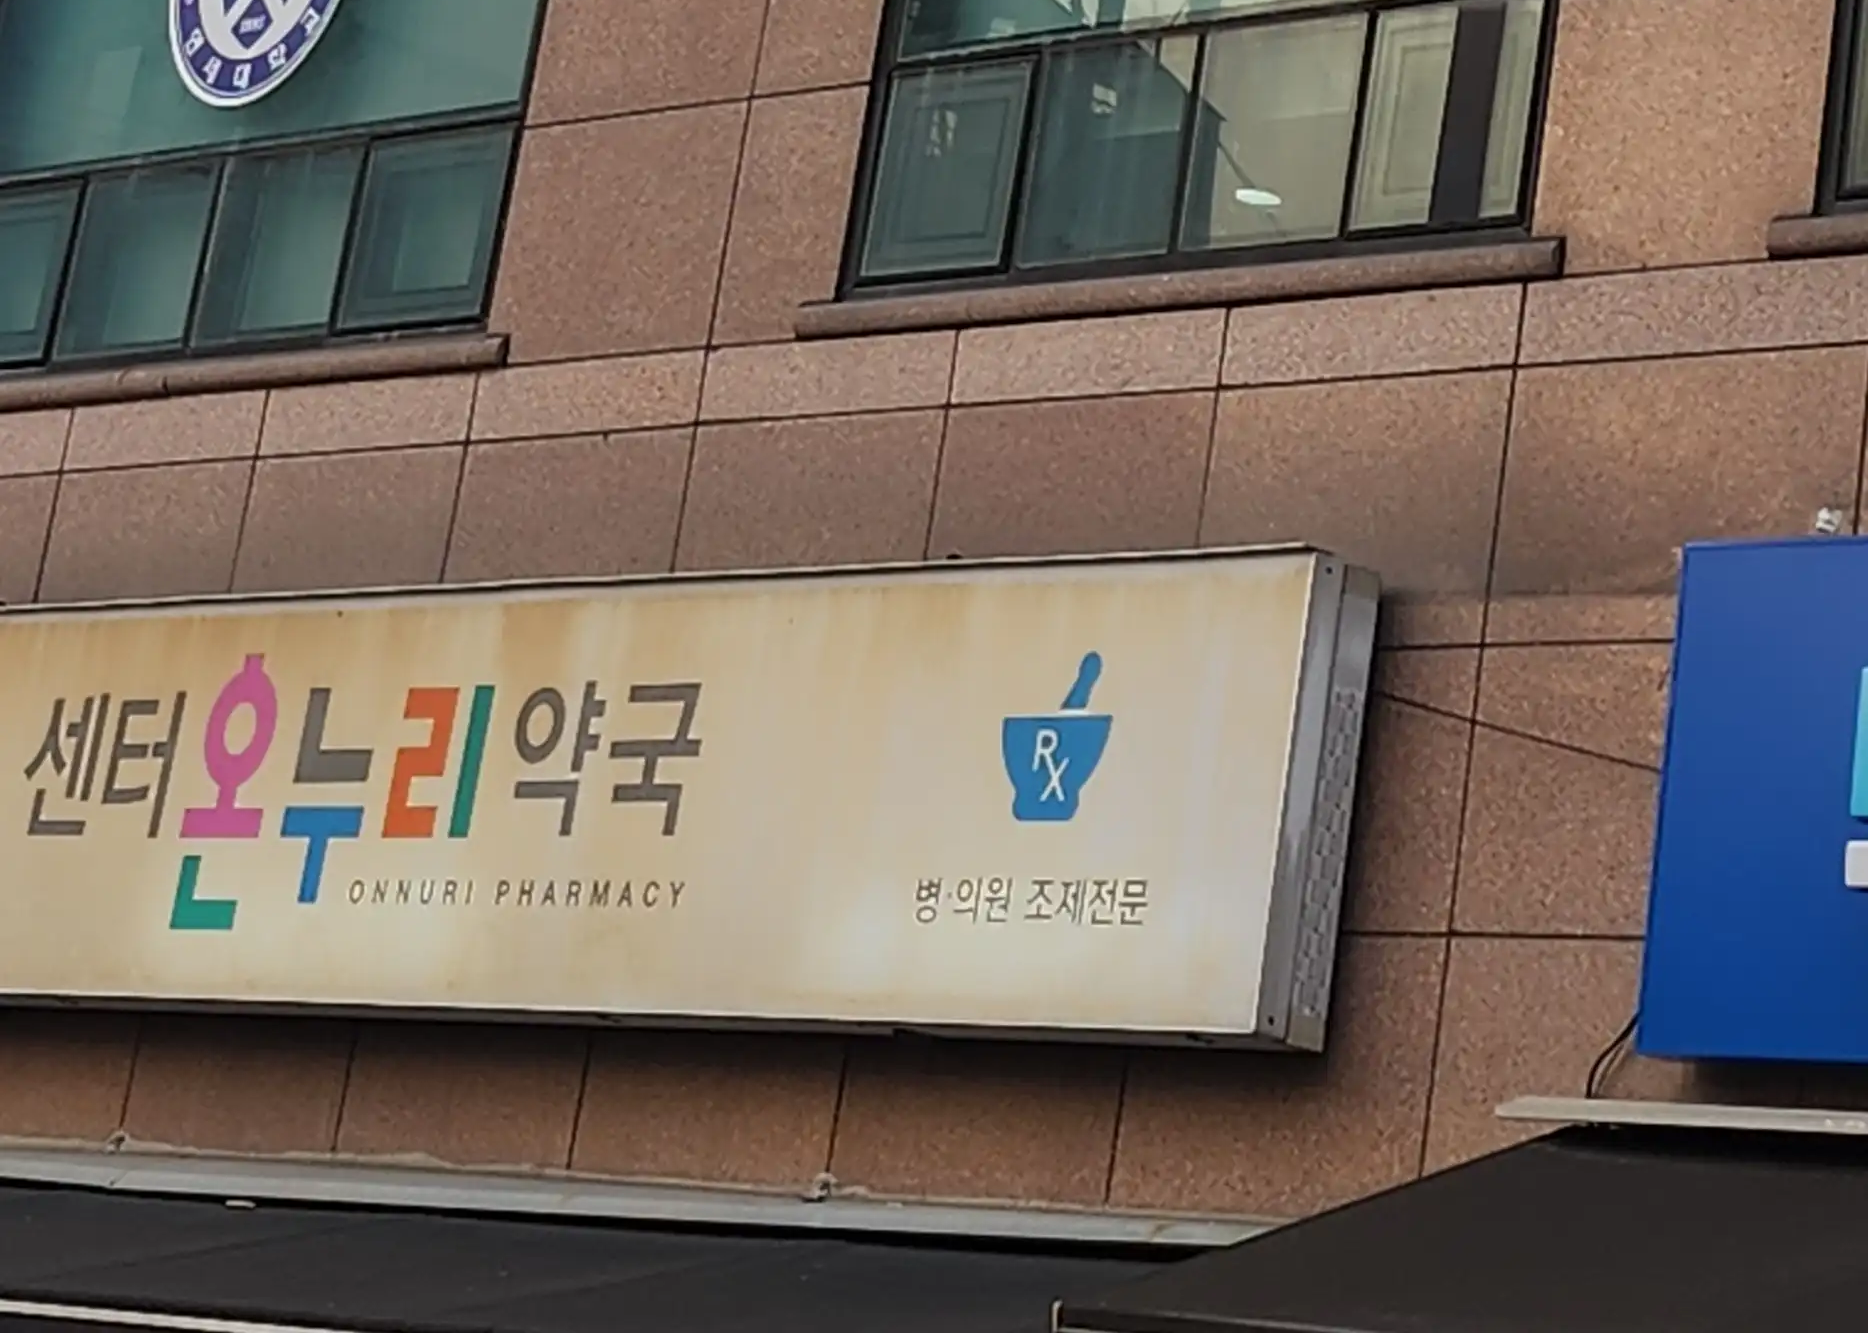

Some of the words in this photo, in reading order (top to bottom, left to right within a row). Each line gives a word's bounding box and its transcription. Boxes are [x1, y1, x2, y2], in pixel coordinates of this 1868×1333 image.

[349, 879, 475, 906] ONNURI
[495, 879, 686, 908] PHARMACY
[1024, 878, 1149, 926] 조제전문
